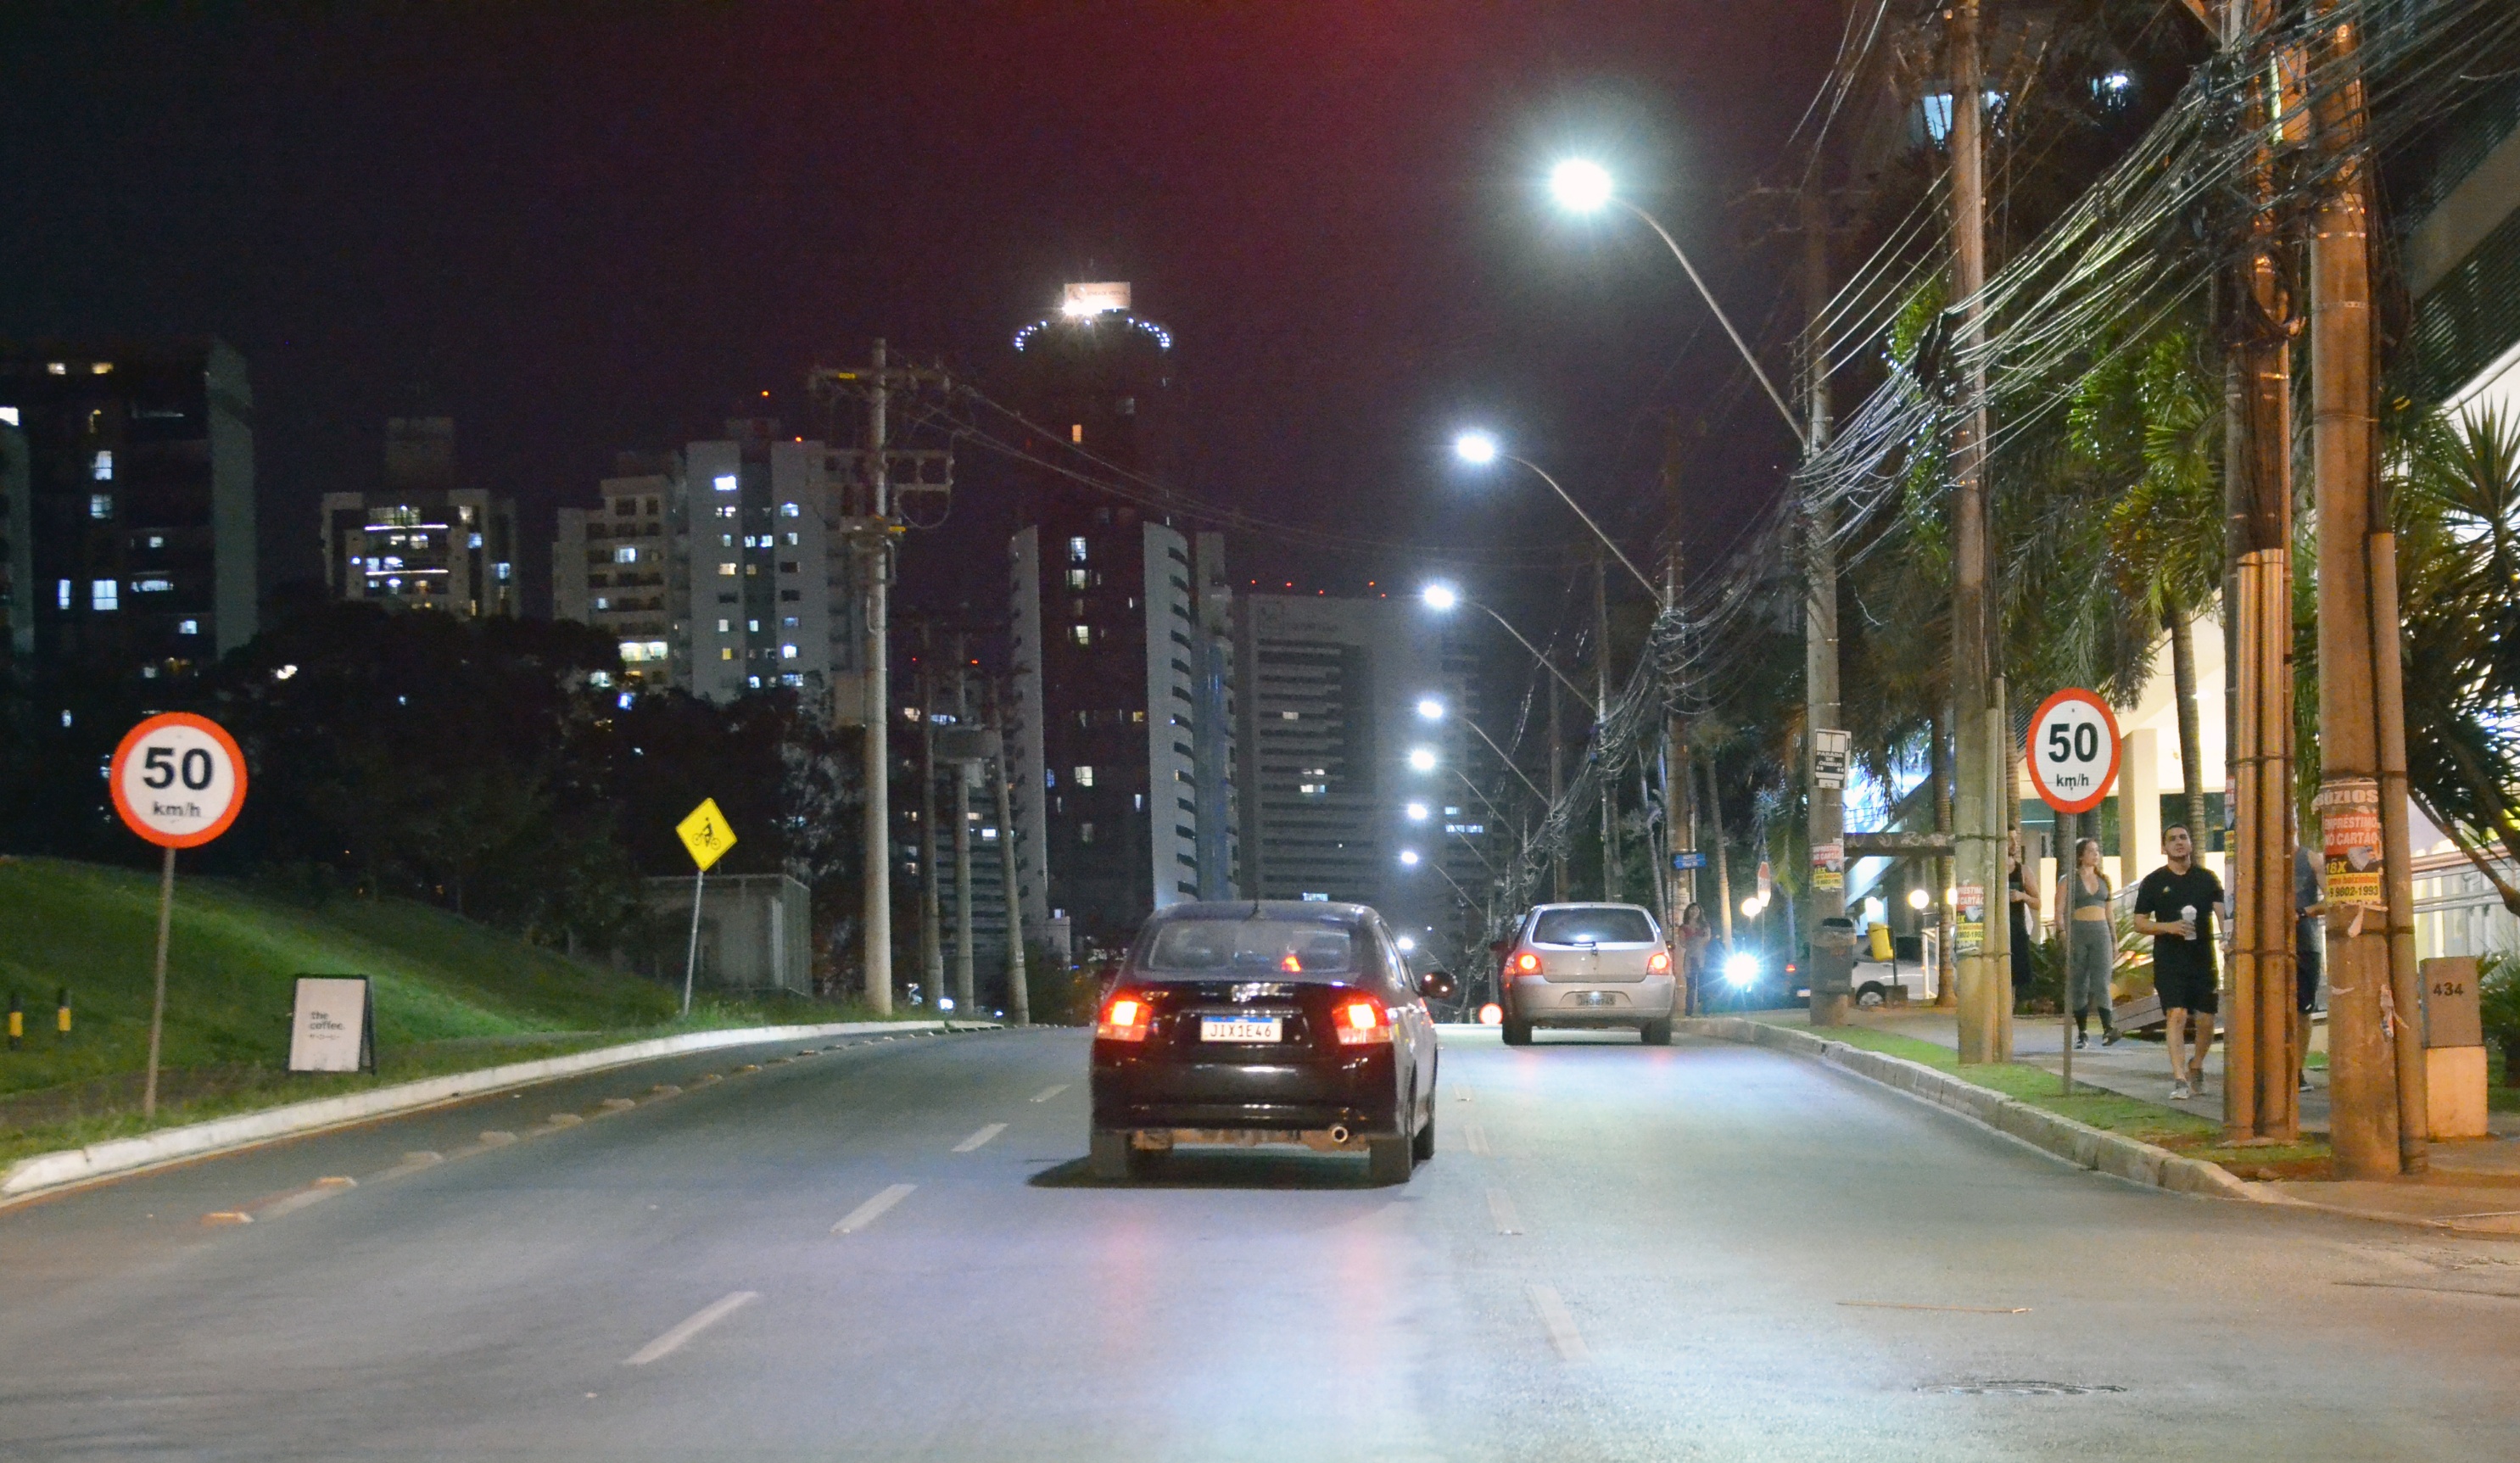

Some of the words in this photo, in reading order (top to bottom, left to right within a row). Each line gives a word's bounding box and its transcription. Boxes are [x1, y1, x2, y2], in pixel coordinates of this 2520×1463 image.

[2048, 722, 2098, 763] 50
[142, 747, 214, 790] 50
[2056, 773, 2089, 787] km/h
[153, 801, 202, 817] km/h
[2433, 982, 2464, 997] 434
[1210, 1025, 1271, 1037] JIX1E46
